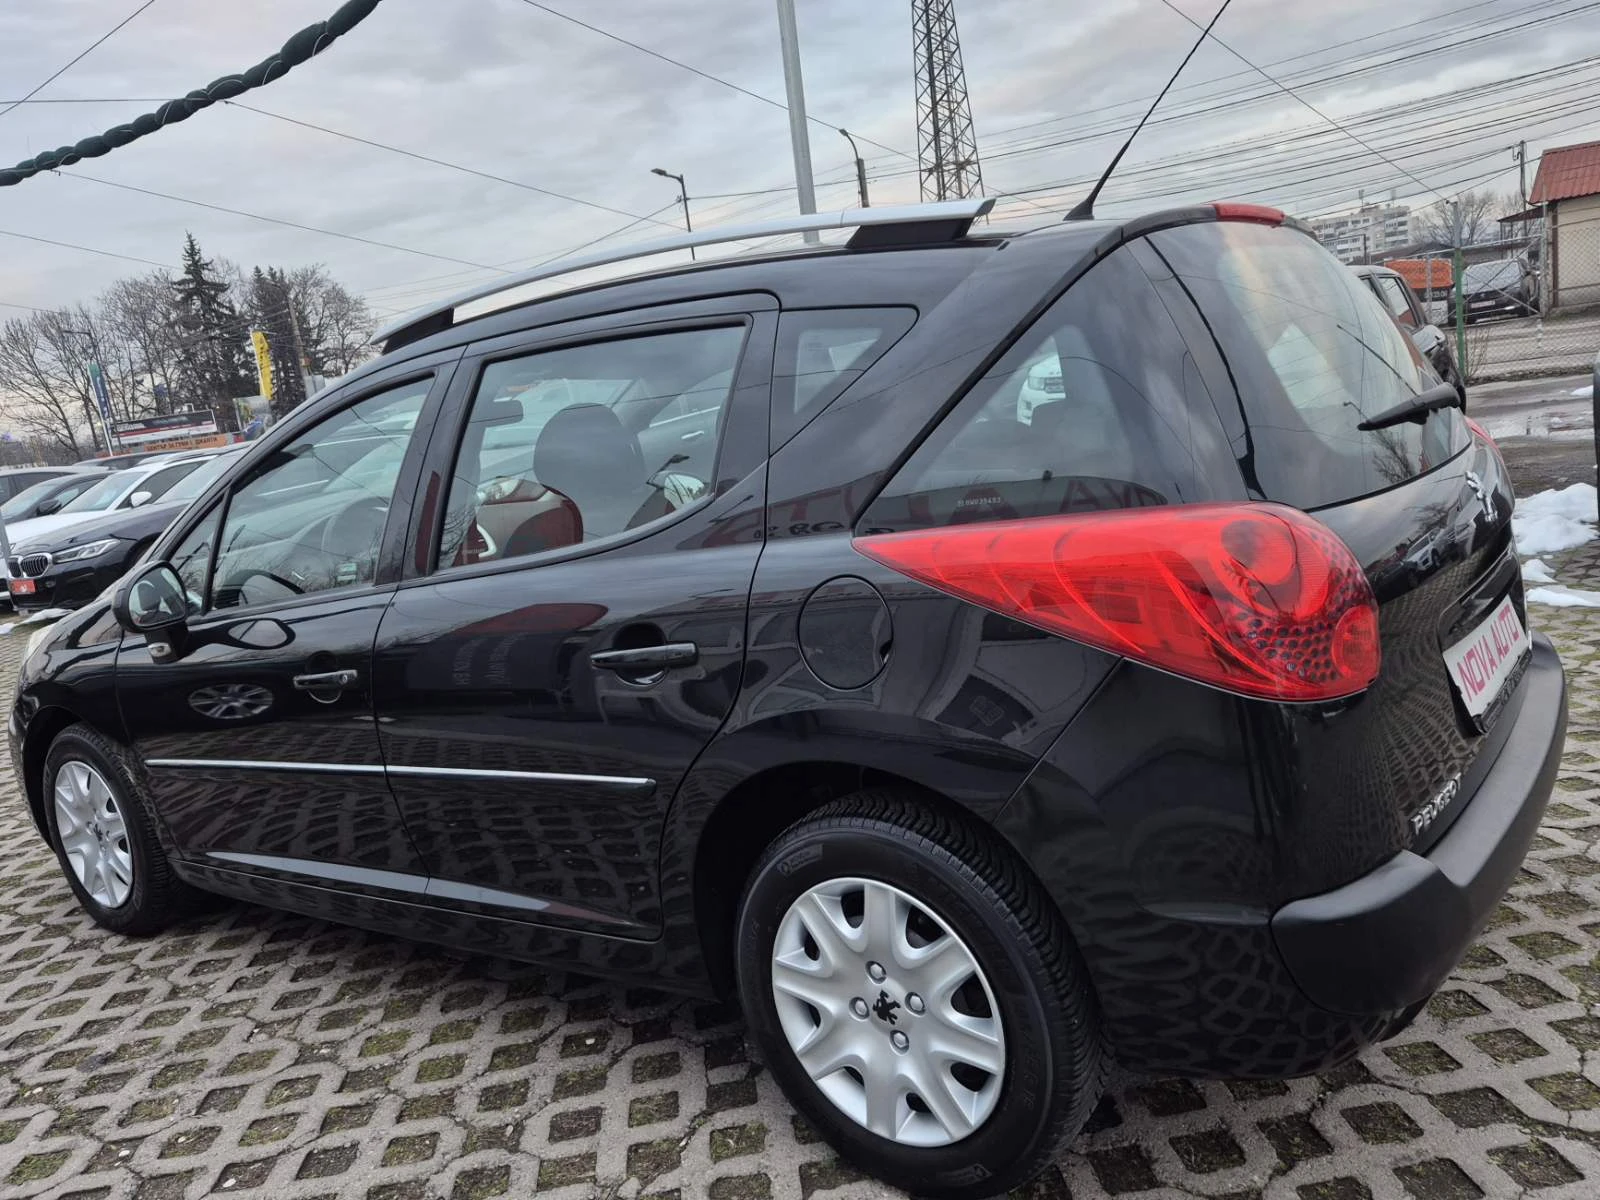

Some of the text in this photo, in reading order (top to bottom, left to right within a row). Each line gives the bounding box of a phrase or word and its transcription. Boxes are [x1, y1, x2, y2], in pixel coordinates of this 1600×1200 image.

[1457, 634, 1498, 703] NOVA
[1490, 604, 1520, 664] AUTO
[1410, 772, 1462, 835] PEUGEOT
